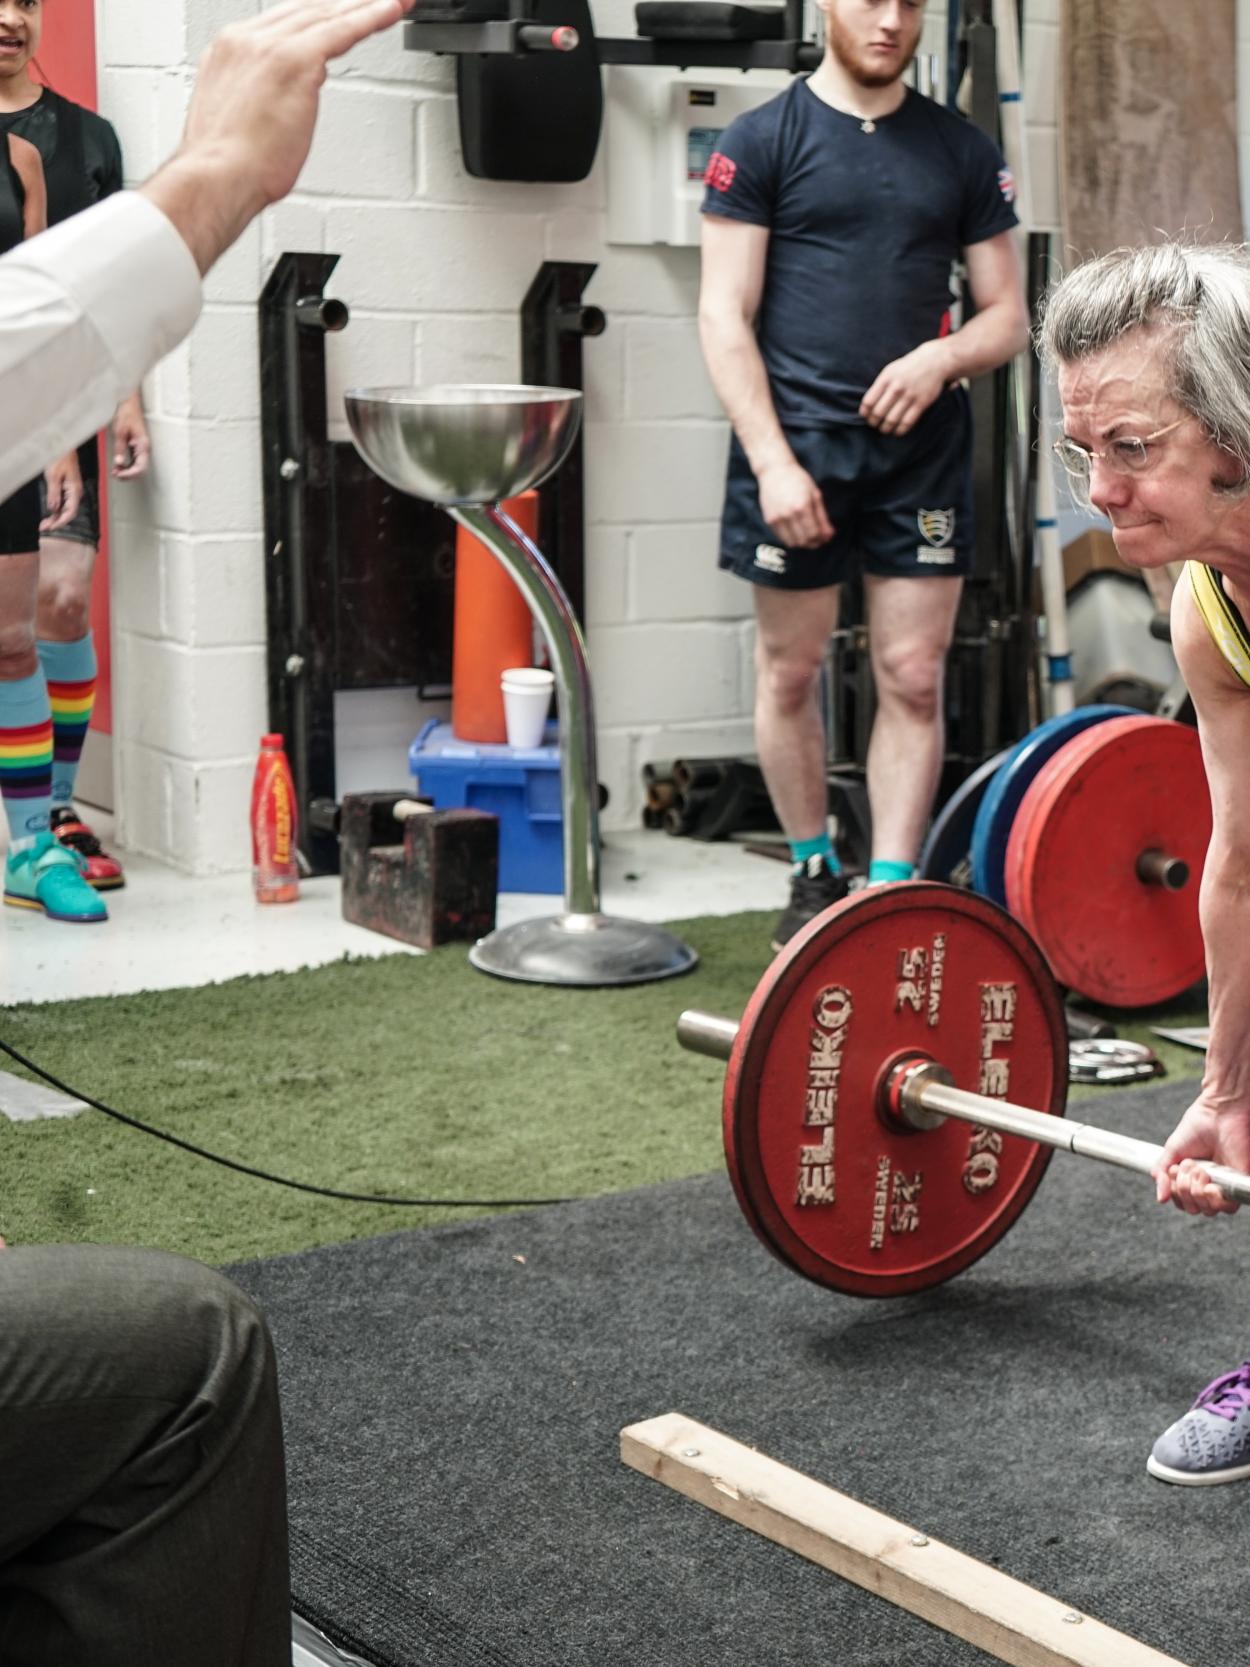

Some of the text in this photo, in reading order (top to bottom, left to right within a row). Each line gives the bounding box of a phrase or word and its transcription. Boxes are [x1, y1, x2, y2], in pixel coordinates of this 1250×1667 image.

[894, 946, 929, 1013] 25
[927, 932, 948, 1027] SWEDEN
[795, 984, 854, 1208] ELEIKO
[961, 982, 1019, 1195] ELEKO
[870, 1155, 890, 1250] SWEDEN
[889, 1170, 924, 1233] 25
